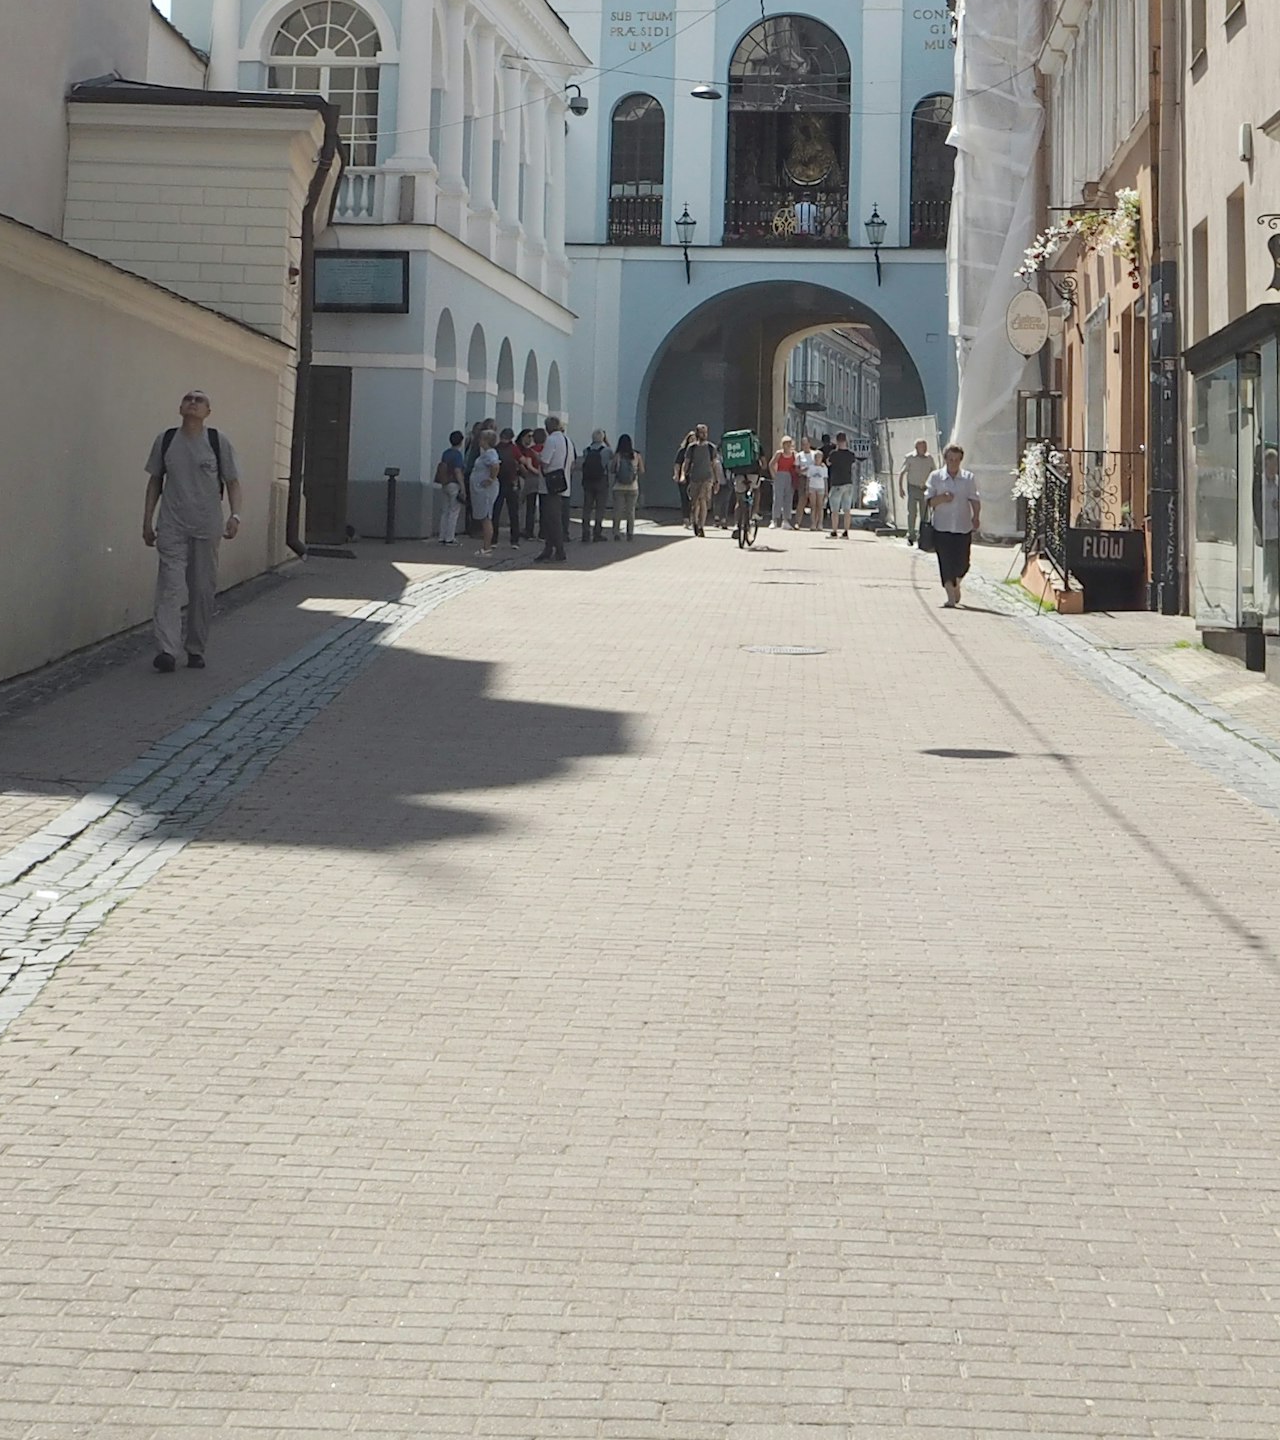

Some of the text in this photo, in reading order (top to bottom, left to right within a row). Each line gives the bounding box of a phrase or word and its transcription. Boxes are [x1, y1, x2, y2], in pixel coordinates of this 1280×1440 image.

[610, 11, 673, 21] SUB TUUM
[629, 41, 652, 51] UM
